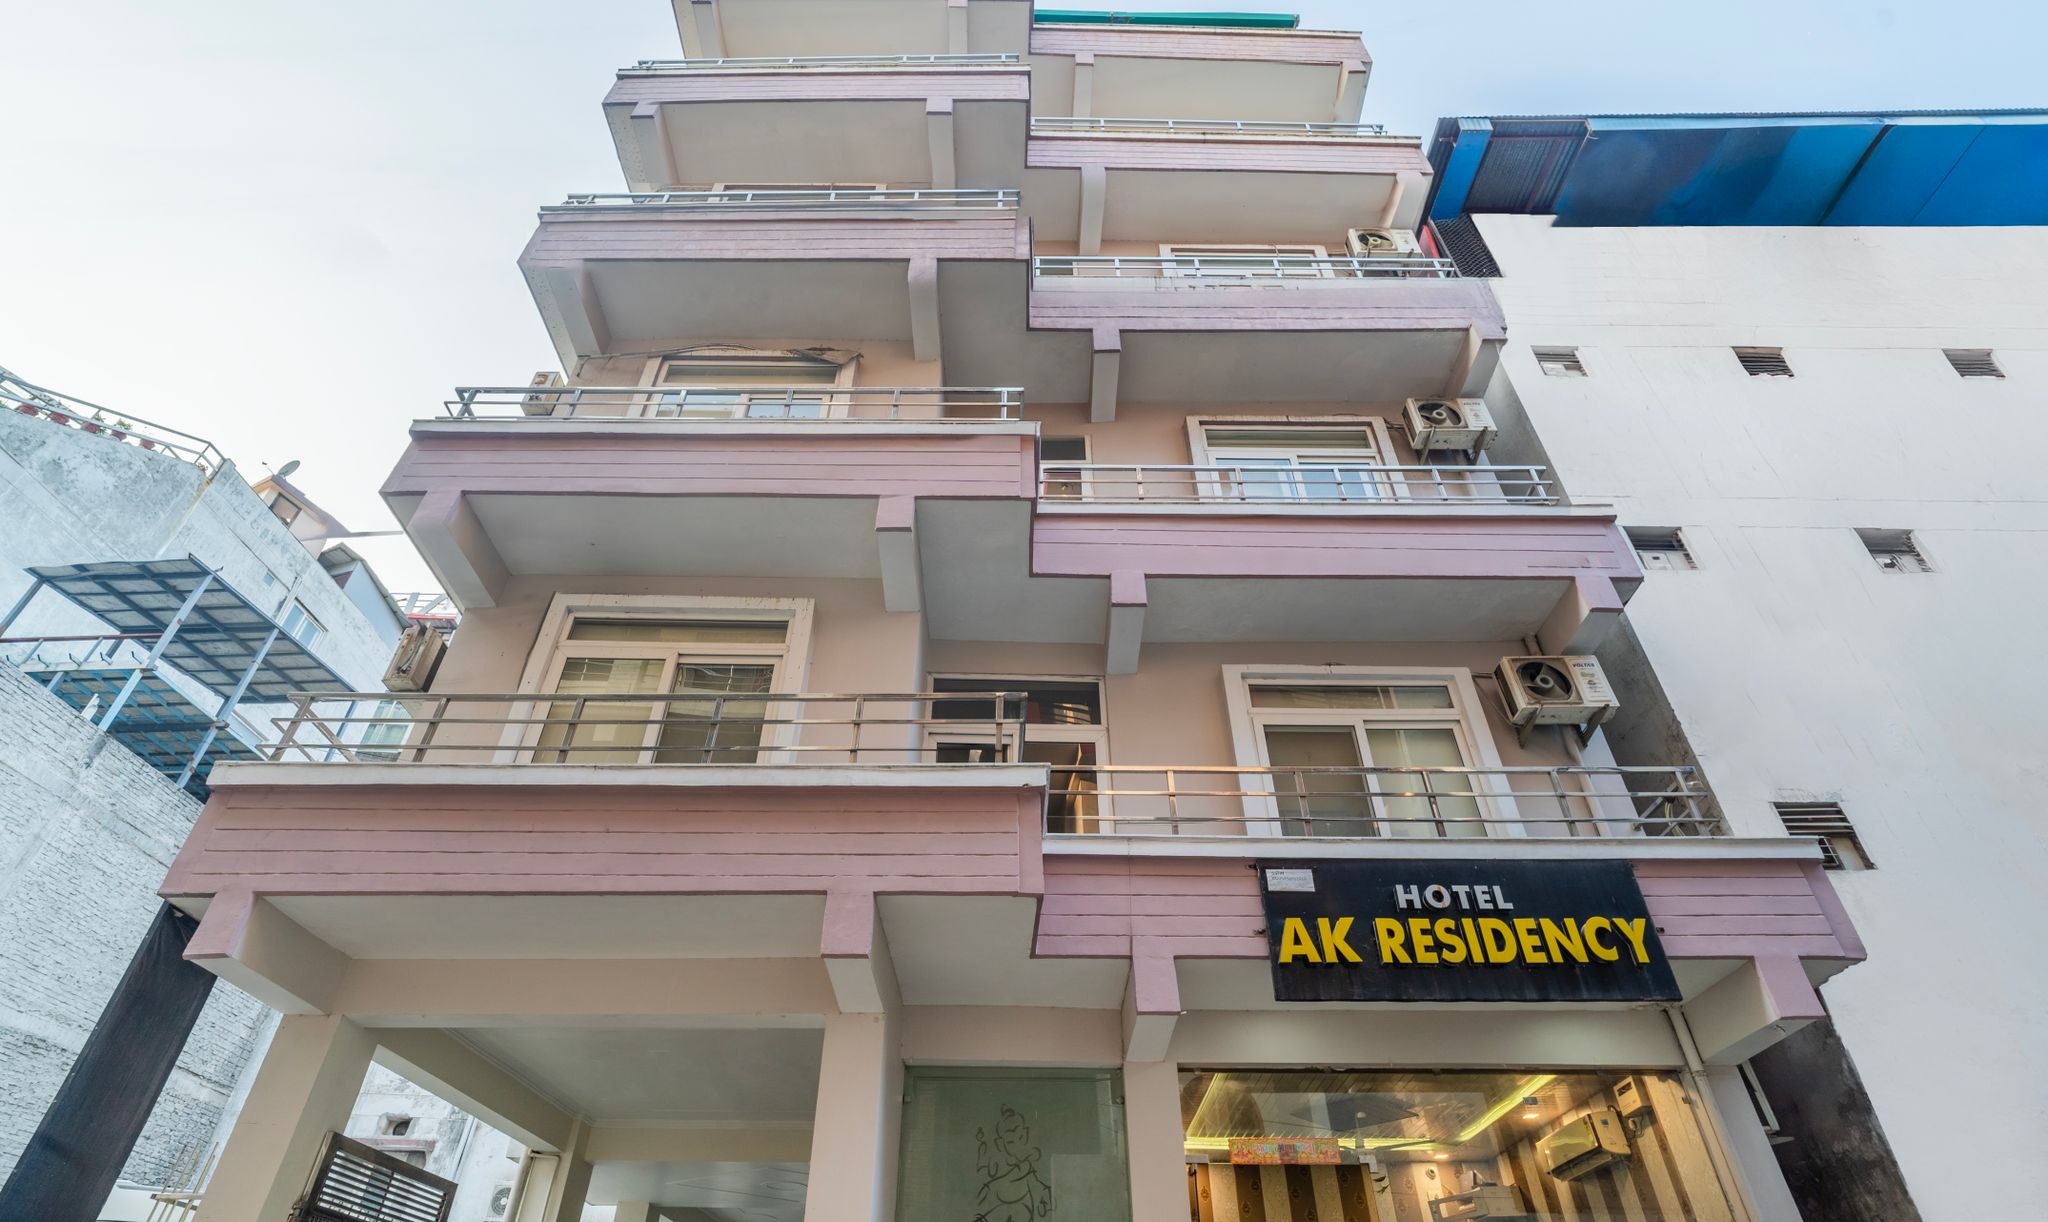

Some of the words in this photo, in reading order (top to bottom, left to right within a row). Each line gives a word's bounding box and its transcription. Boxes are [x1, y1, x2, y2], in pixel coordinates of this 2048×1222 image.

[1395, 884, 1514, 910] HOTEL
[1279, 917, 1362, 964] AK
[1375, 916, 1649, 964] RESIDENCY
